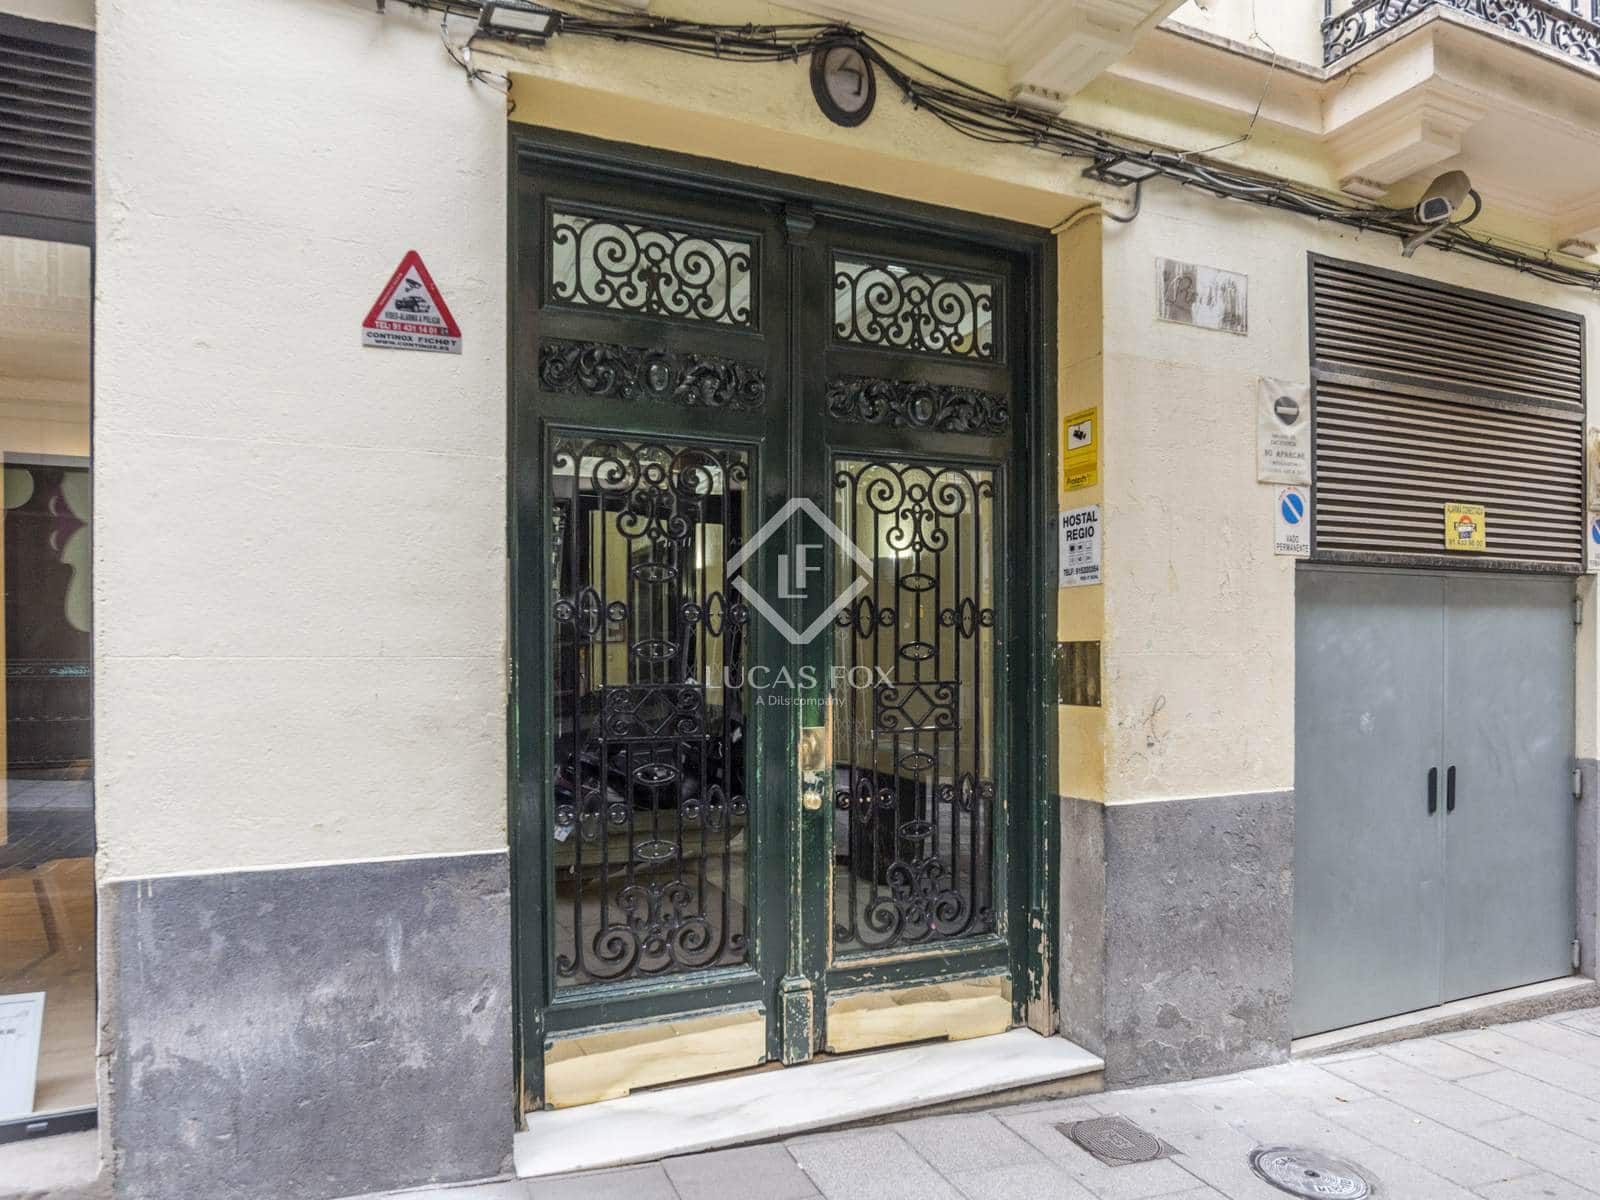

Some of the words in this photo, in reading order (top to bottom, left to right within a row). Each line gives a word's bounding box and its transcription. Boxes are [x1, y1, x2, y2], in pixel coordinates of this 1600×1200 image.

[393, 322, 401, 330] 91
[403, 324, 418, 332] 431
[366, 331, 413, 342] CONTINOX
[1063, 511, 1098, 528] HOSTAL
[1066, 526, 1095, 541] REGIO
[1275, 543, 1310, 552] PERMANENTE
